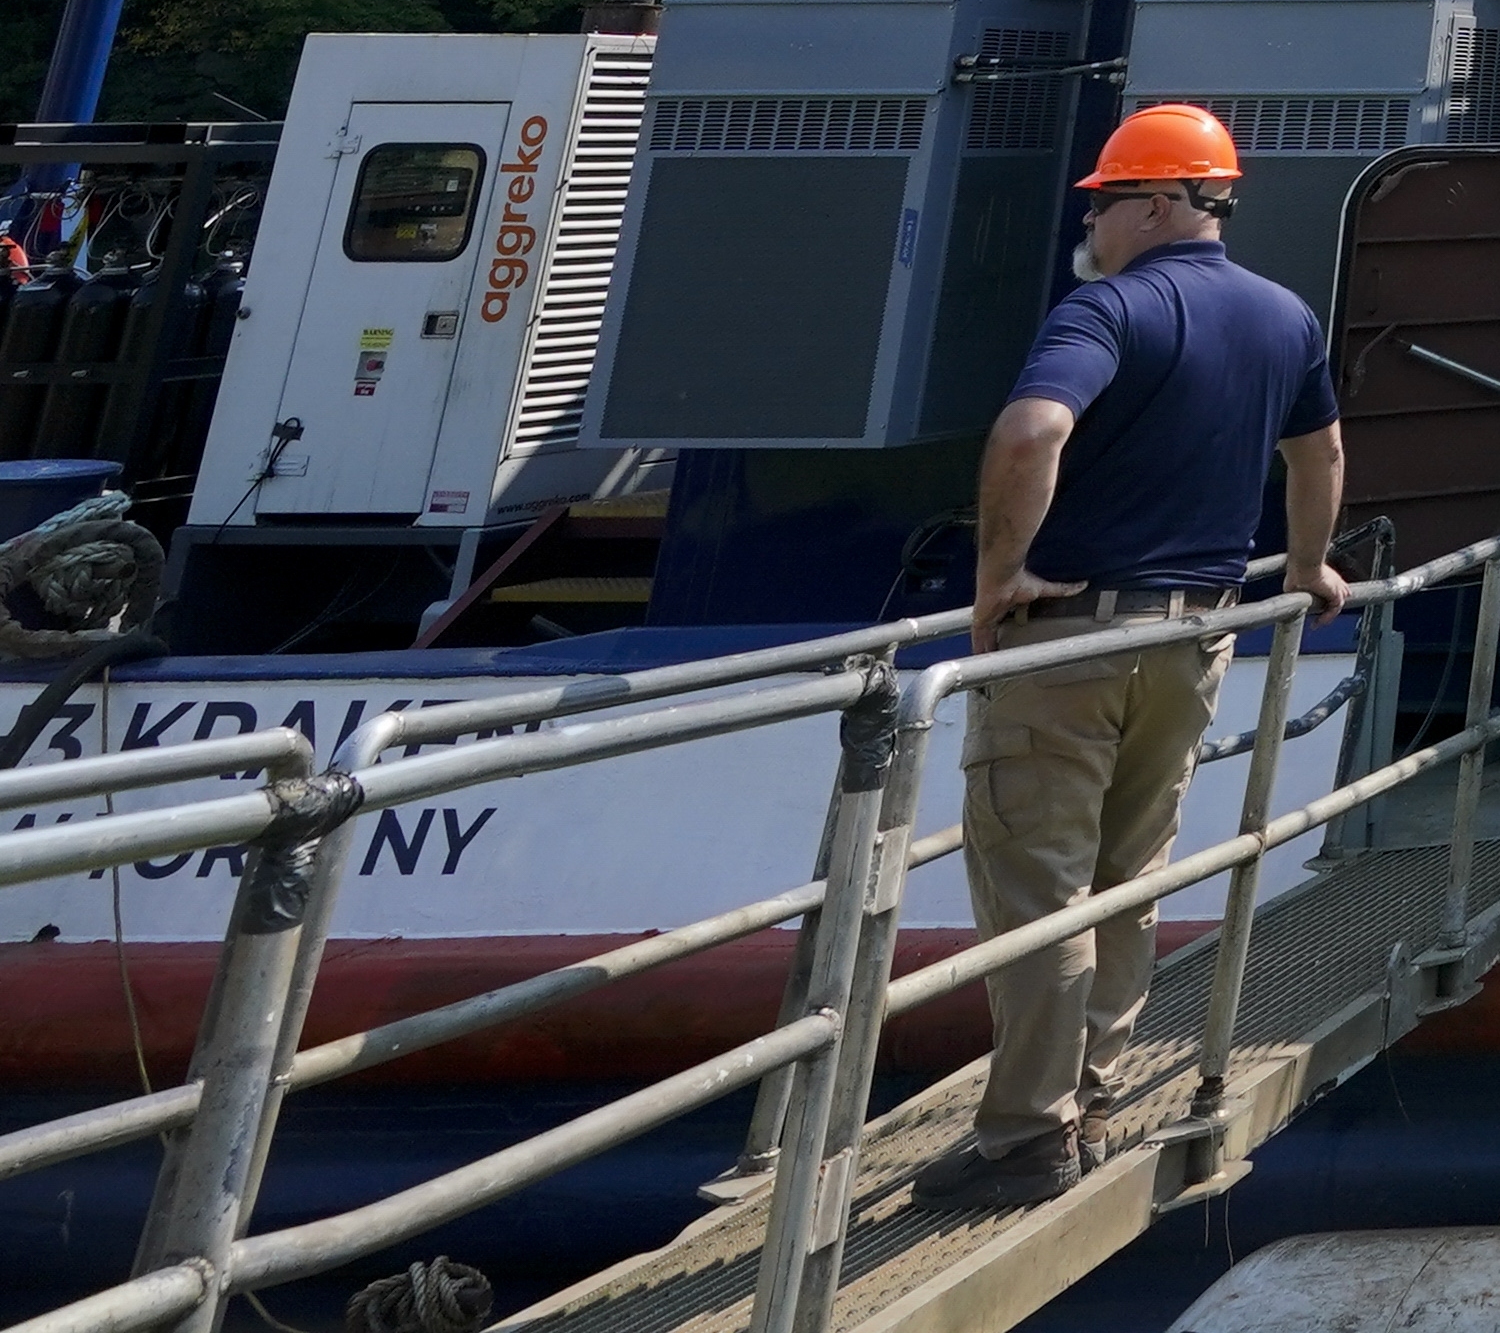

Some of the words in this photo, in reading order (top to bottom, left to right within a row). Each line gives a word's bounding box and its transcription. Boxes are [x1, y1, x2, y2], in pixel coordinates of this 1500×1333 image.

[481, 115, 548, 324] aggreko
[120, 699, 546, 781] KRA
[359, 807, 498, 877] NY
